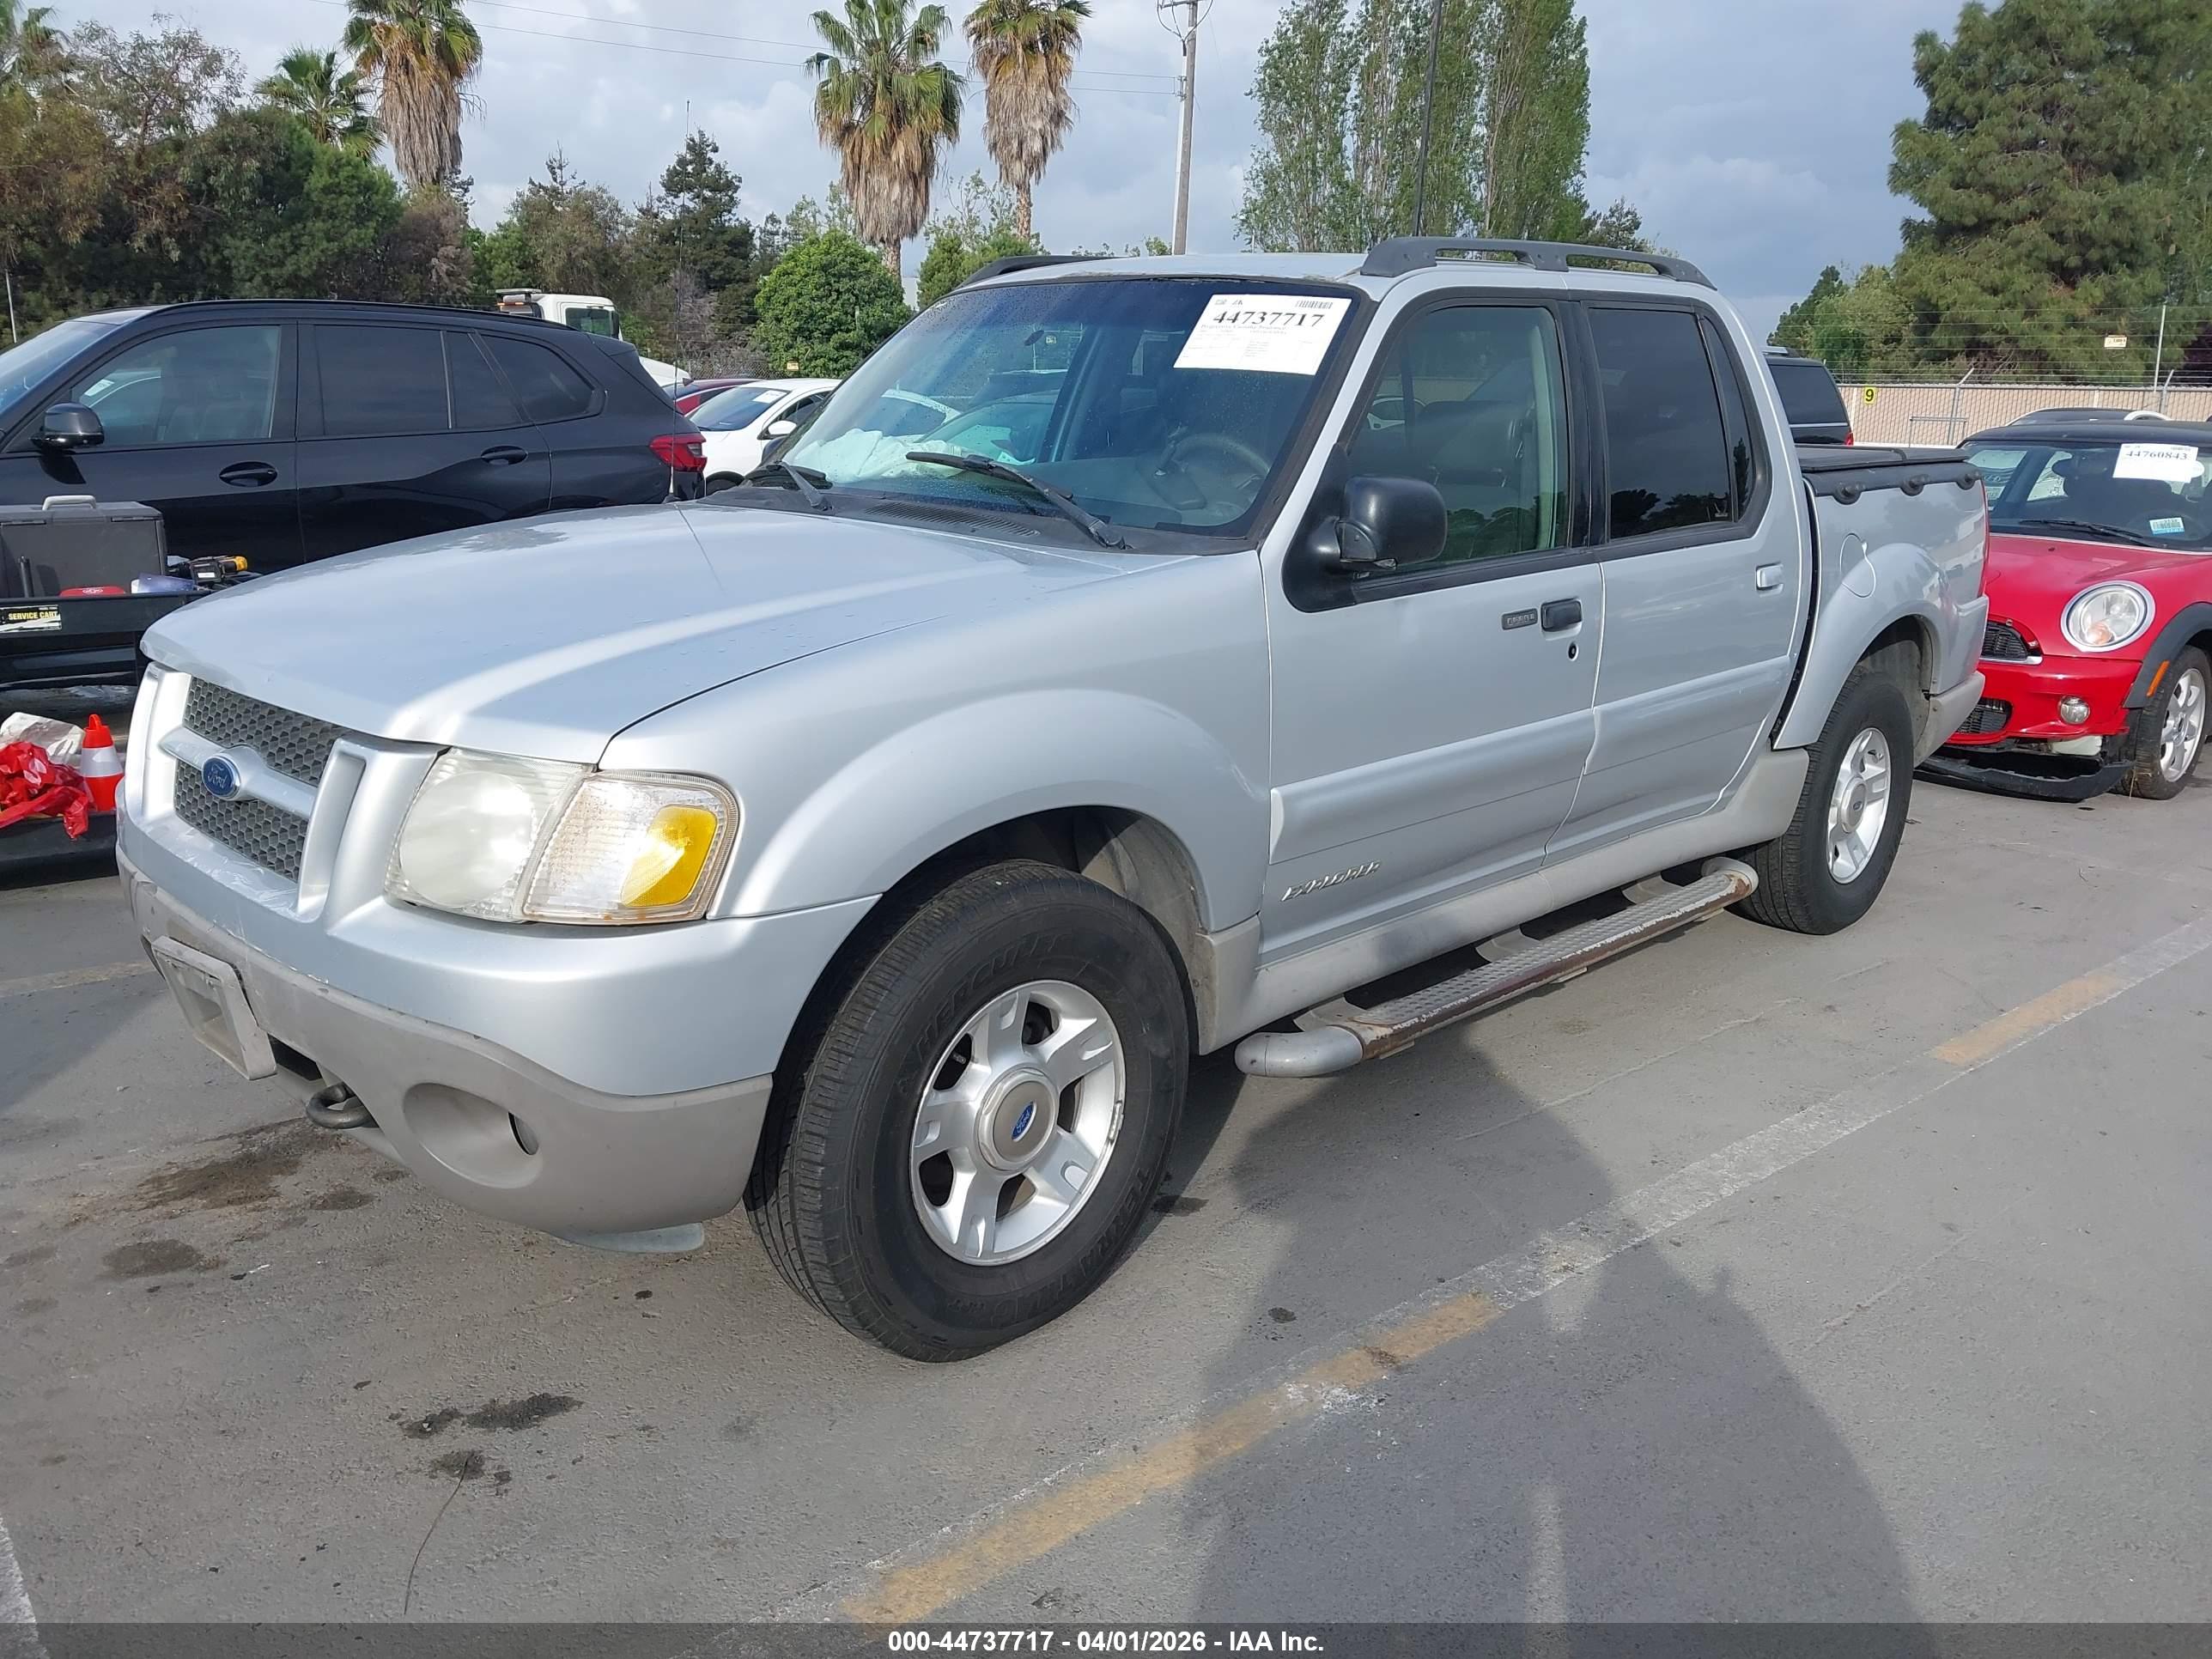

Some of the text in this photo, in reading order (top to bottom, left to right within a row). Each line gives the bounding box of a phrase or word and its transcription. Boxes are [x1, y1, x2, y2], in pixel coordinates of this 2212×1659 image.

[1212, 310, 1325, 327] 44737717
[1865, 388, 1875, 402] 9
[2125, 450, 2188, 460] 44760843
[8, 611, 58, 620] SERVICE CART
[1279, 861, 1381, 902] EXPLORER
